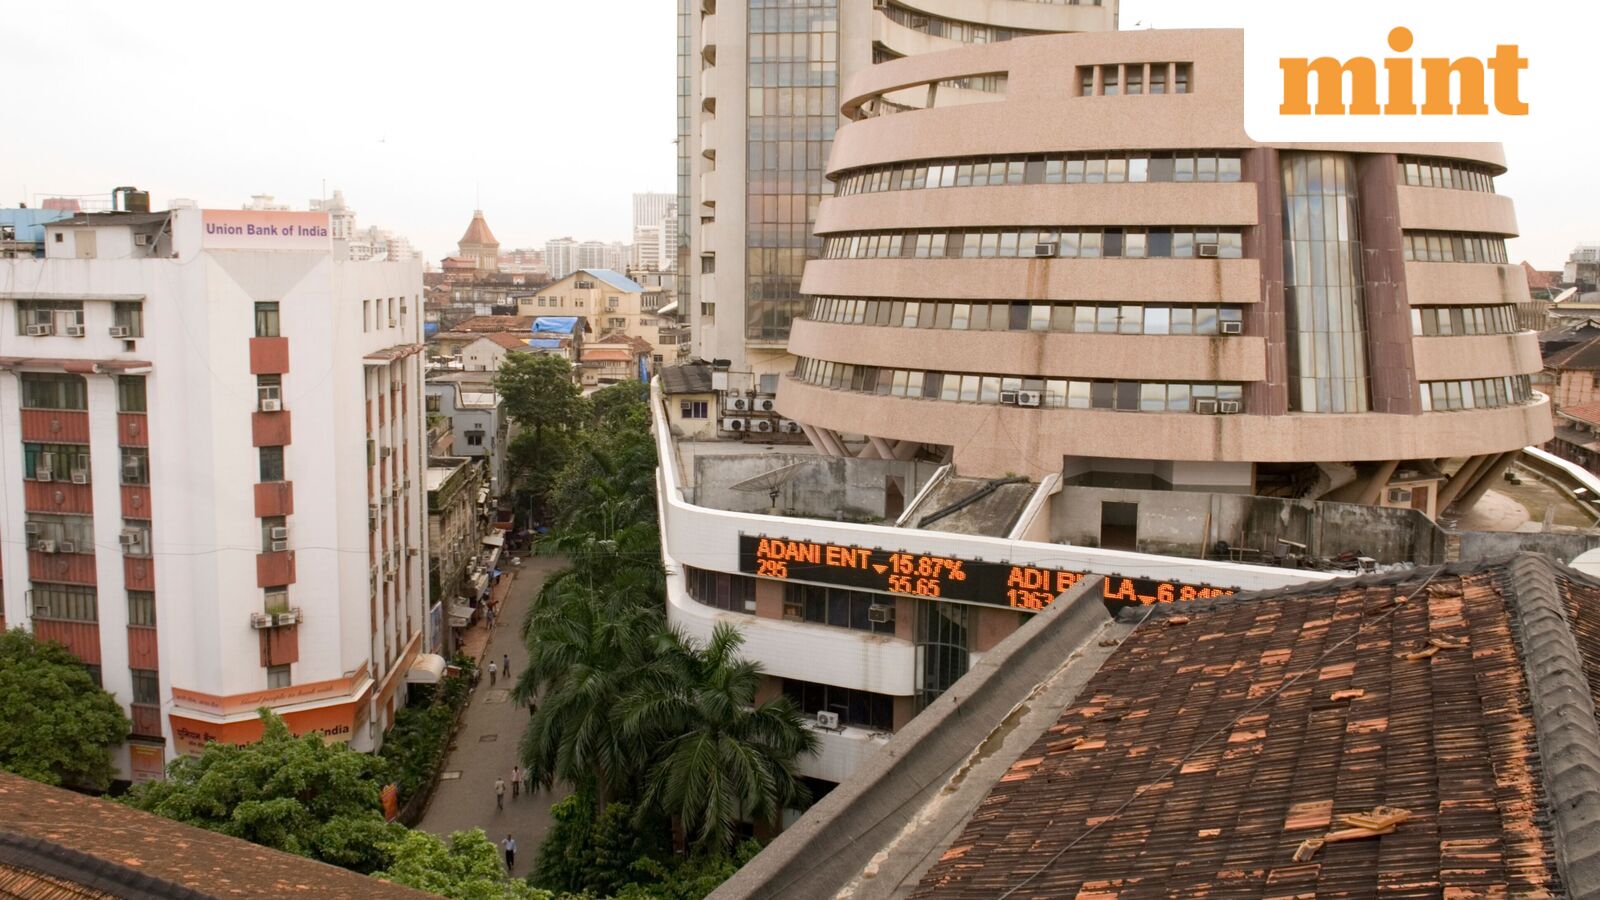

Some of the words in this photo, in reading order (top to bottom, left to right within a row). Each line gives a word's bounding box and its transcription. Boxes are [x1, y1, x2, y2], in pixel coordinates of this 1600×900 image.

[206, 223, 243, 235] Union
[246, 224, 279, 236] Bank
[281, 225, 294, 236] of
[297, 225, 328, 237] India
[756, 538, 821, 564] ADANI
[826, 546, 872, 570] ENT
[889, 553, 967, 581] 15.87%
[756, 558, 788, 579] 295
[888, 574, 941, 597] 55.65
[1006, 566, 1051, 591] ADI
[321, 725, 350, 737] ndia
